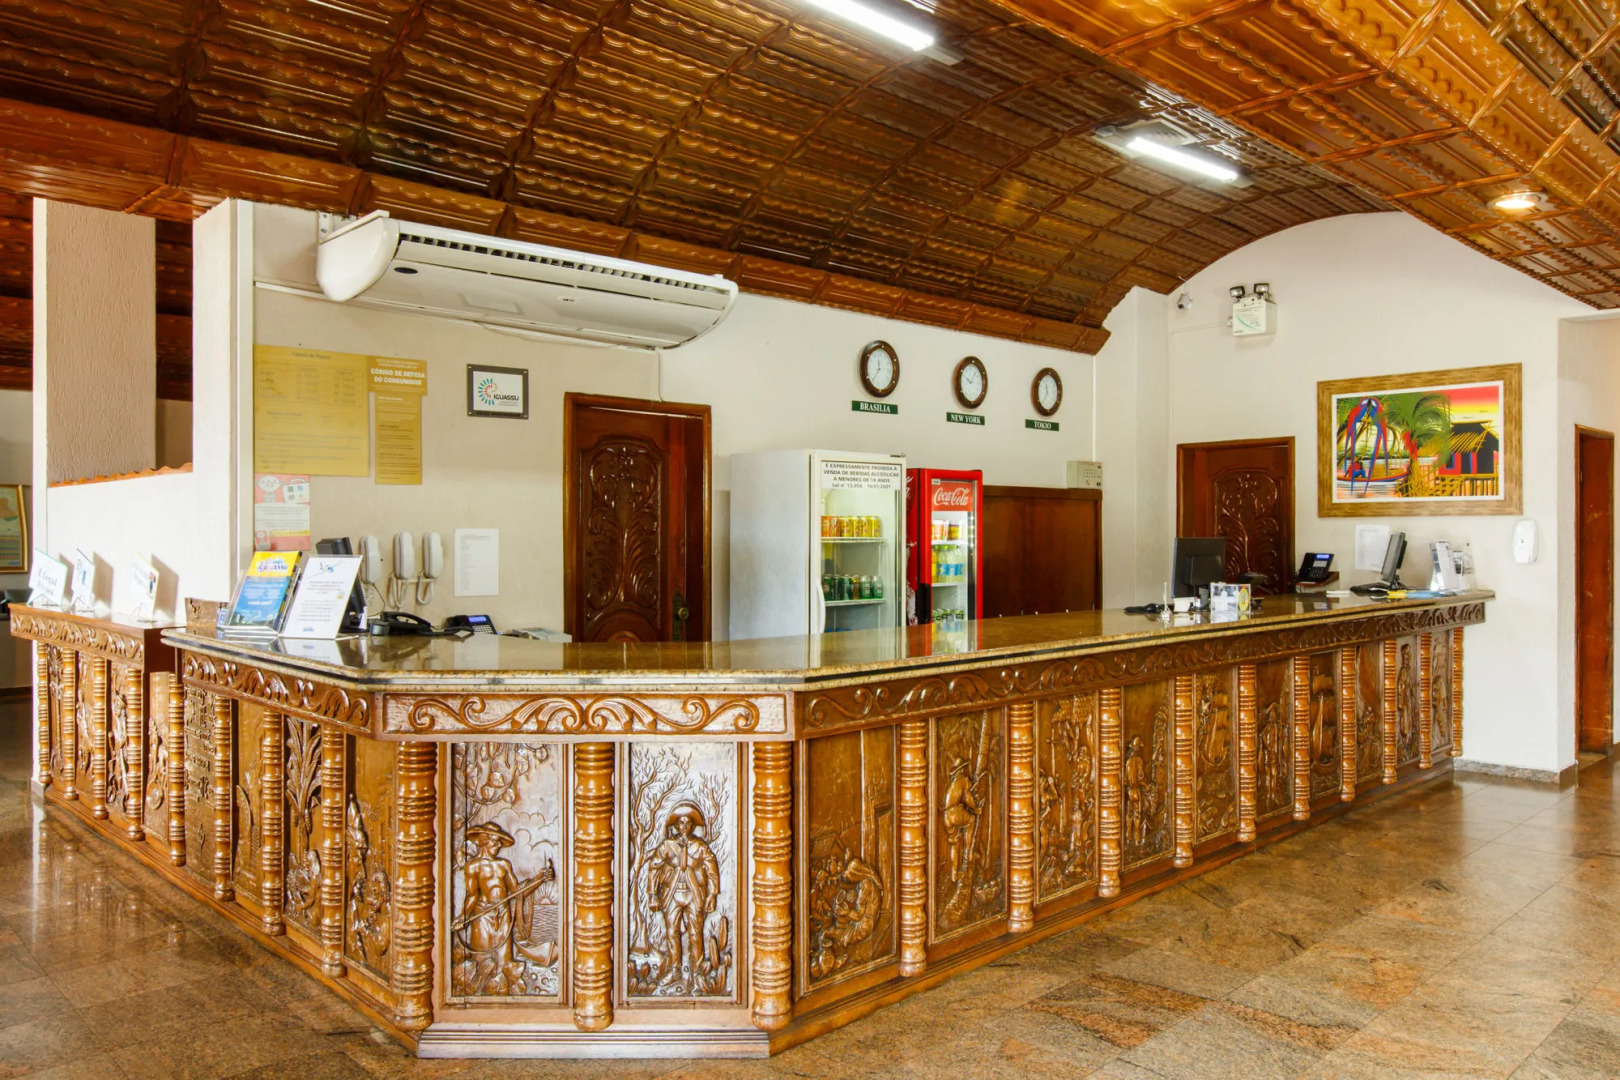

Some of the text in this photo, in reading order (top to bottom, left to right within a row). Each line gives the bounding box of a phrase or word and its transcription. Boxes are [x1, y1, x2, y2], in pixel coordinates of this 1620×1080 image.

[383, 377, 422, 386] CONSUMIDOR
[950, 413, 981, 424] NEW YORK
[1033, 420, 1052, 430] TOKIO
